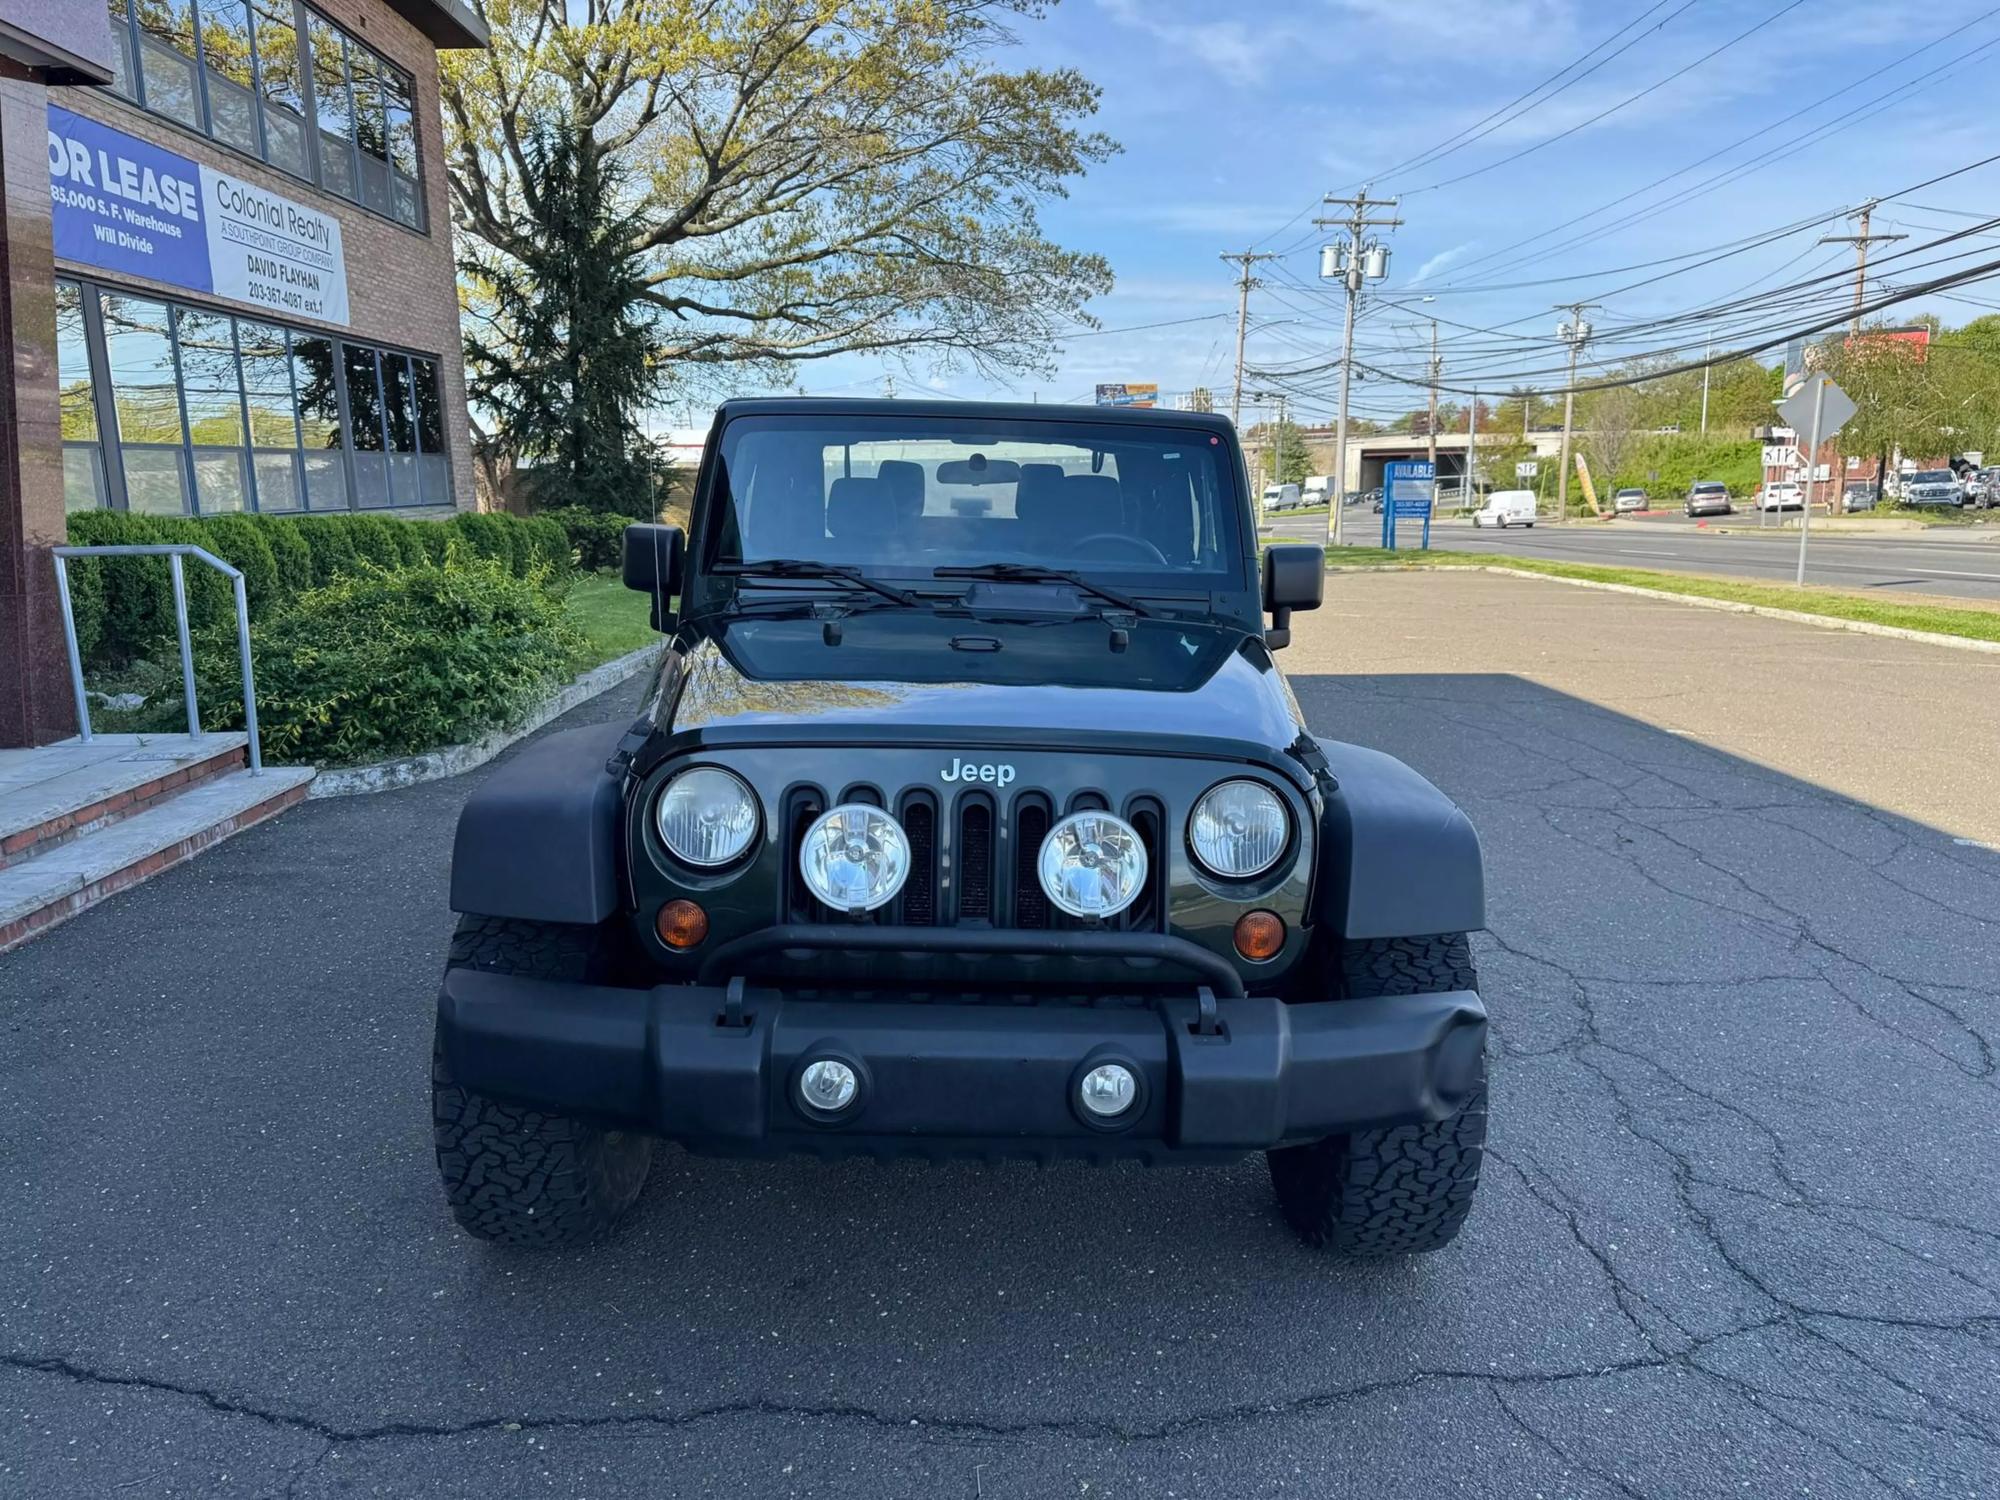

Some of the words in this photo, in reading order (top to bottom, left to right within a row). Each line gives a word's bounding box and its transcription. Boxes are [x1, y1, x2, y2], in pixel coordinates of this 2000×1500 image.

[98, 150, 199, 222] LEASE
[50, 184, 96, 212] 85,000
[98, 200, 110, 217] S.
[110, 203, 123, 221] F.
[123, 207, 182, 239] Warehouse
[217, 180, 284, 230] Colonial
[288, 206, 330, 250] Realty
[93, 223, 117, 244] Will
[118, 231, 153, 255] Divide
[221, 221, 227, 234] A
[228, 223, 276, 250] SOUTHPOINT
[277, 240, 302, 257] GROUP
[303, 249, 334, 268] COMPANY
[247, 254, 277, 279] DAVID
[280, 264, 320, 292] FLAYHAN
[248, 281, 302, 310] 203-367-4087
[1394, 464, 1433, 478] AVAILABLE
[941, 758, 1016, 787] Jeep
